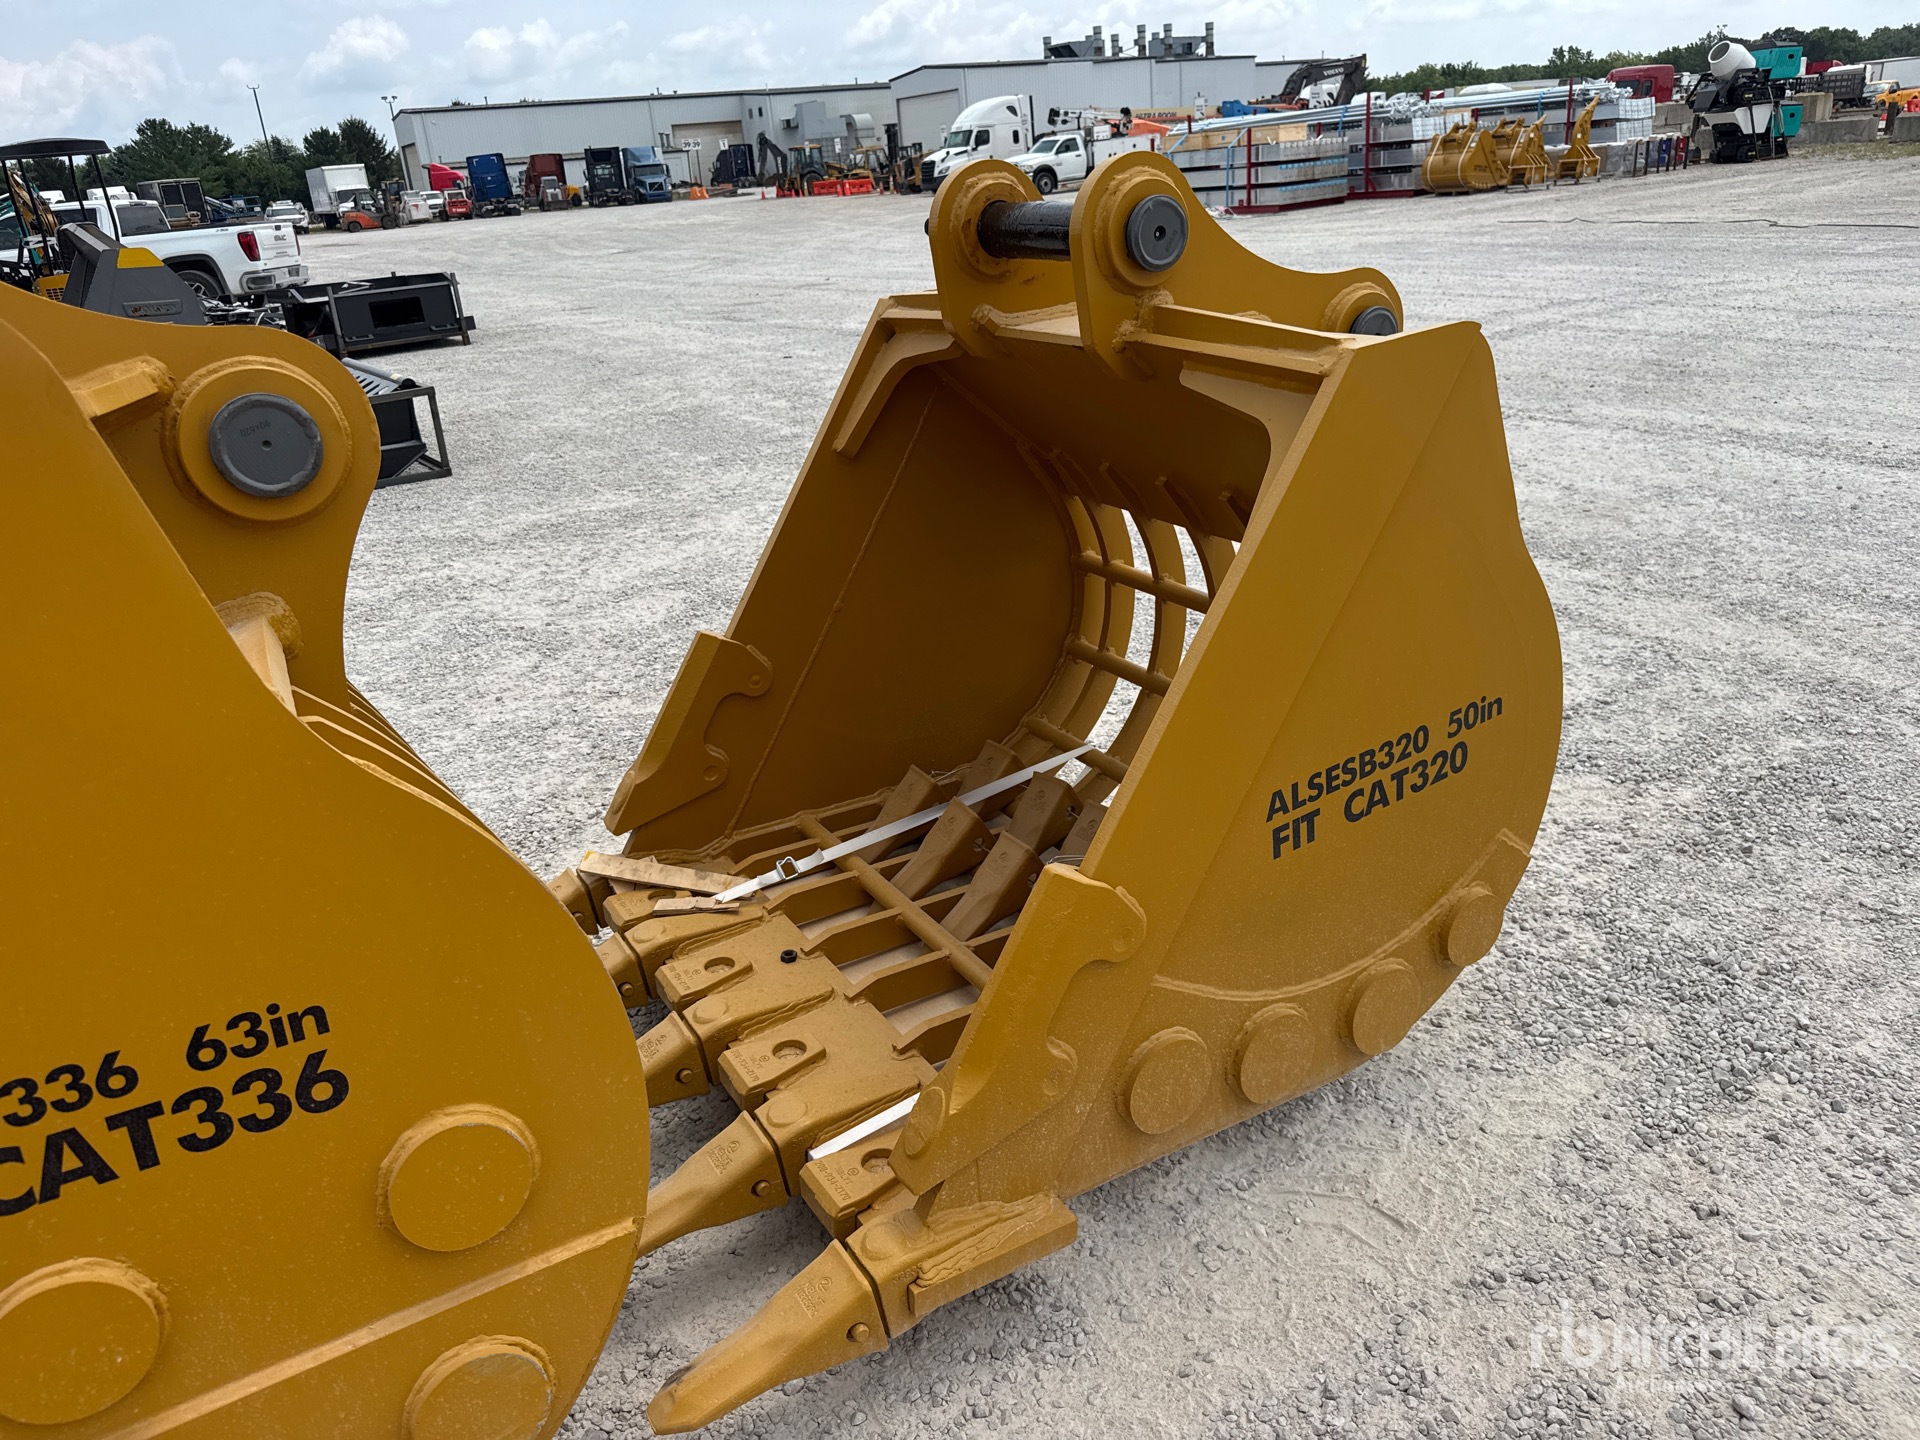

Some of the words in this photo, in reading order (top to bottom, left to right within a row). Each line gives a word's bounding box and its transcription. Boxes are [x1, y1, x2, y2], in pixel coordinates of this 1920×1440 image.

[1266, 725, 1429, 823] ALSESB320
[1447, 695, 1503, 739] 50in
[1271, 808, 1321, 860] FIT
[1343, 741, 1469, 823] CAT320
[186, 1002, 331, 1072] 63in
